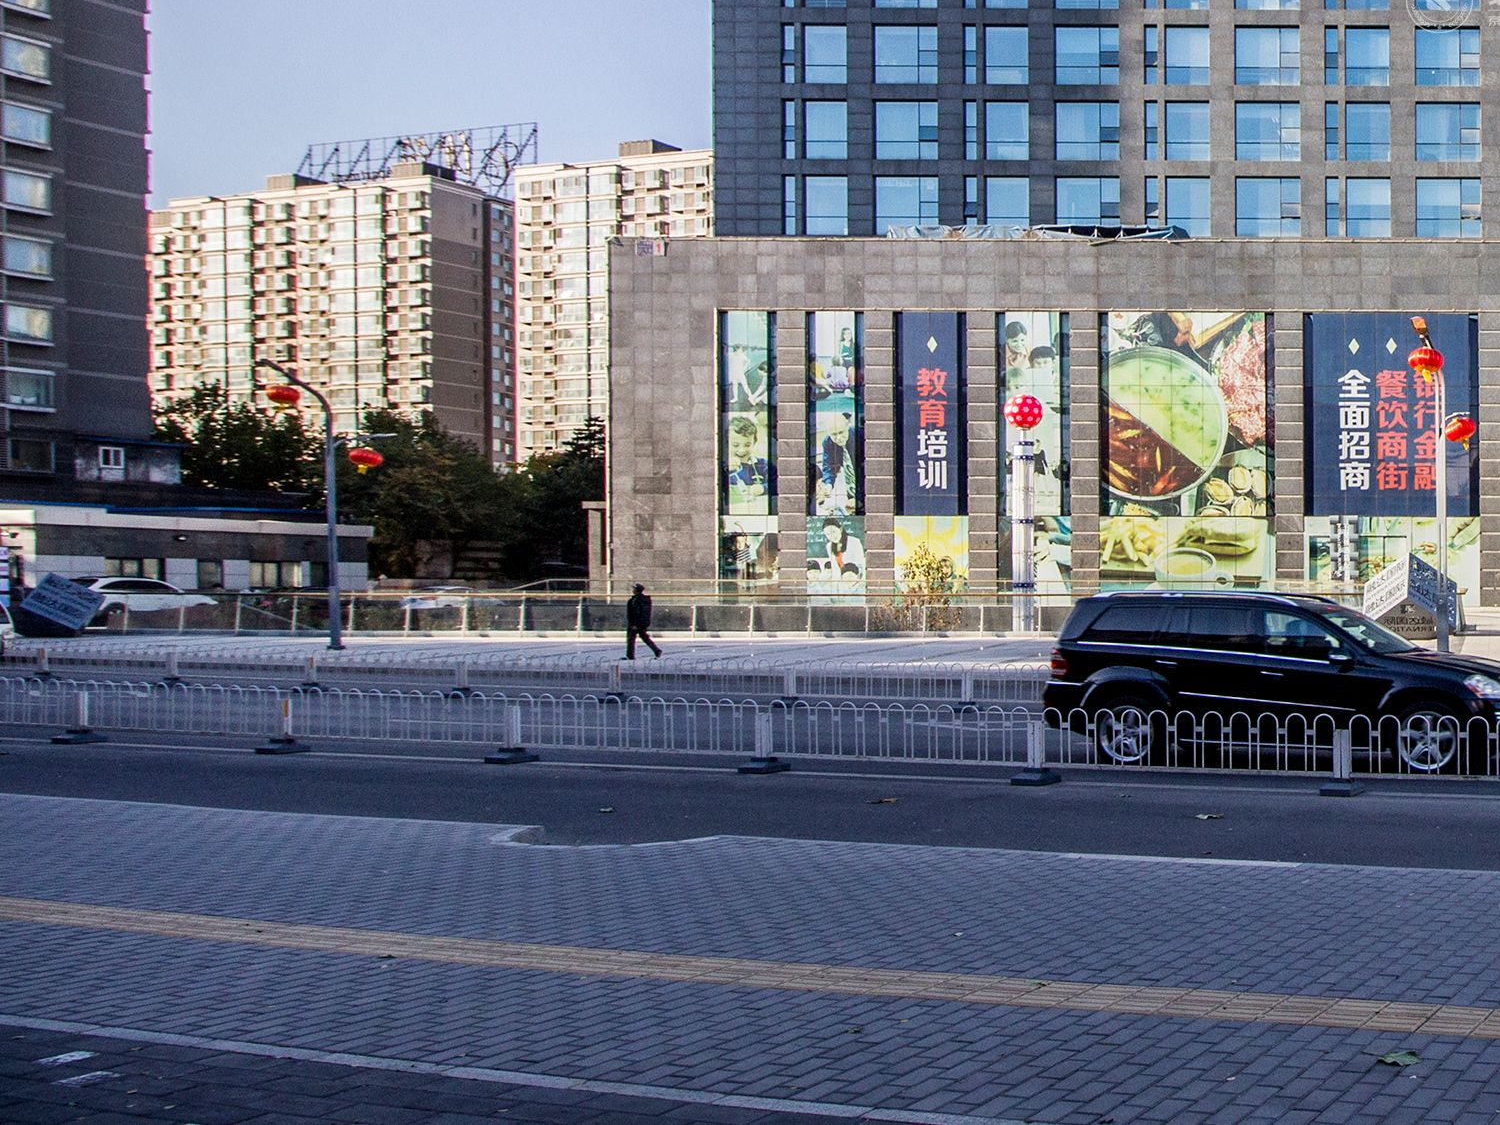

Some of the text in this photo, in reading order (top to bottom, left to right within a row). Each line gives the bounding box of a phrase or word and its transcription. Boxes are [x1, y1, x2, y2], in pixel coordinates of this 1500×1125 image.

[916, 368, 949, 490] 教育培训
[1337, 369, 1372, 491] 全面招商
[1375, 369, 1409, 491] 餐饮商街
